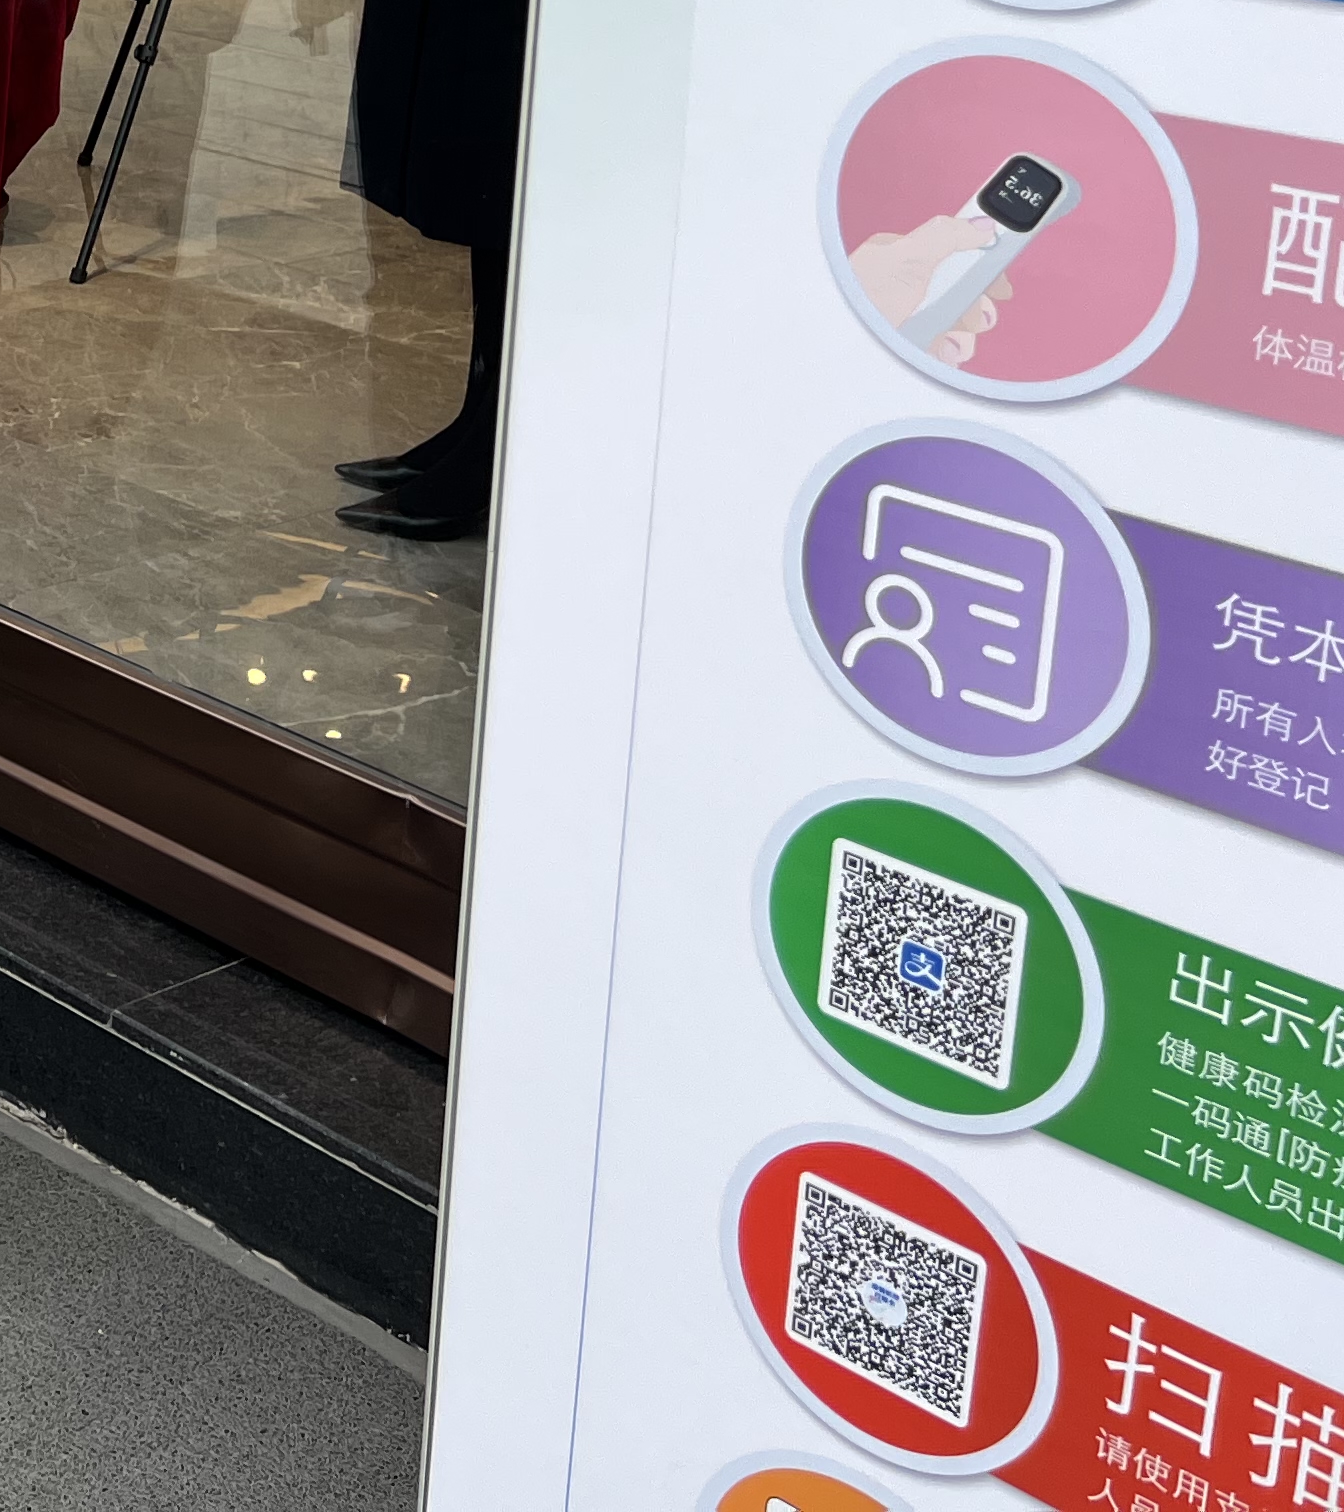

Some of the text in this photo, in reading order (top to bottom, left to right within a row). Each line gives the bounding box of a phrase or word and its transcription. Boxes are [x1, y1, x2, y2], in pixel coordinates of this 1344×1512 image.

[1252, 325, 1344, 381] 体温
[1211, 688, 1344, 756] 所有人
[1205, 739, 1330, 811] 好登记
[1144, 1127, 1344, 1242] 工作人员出
